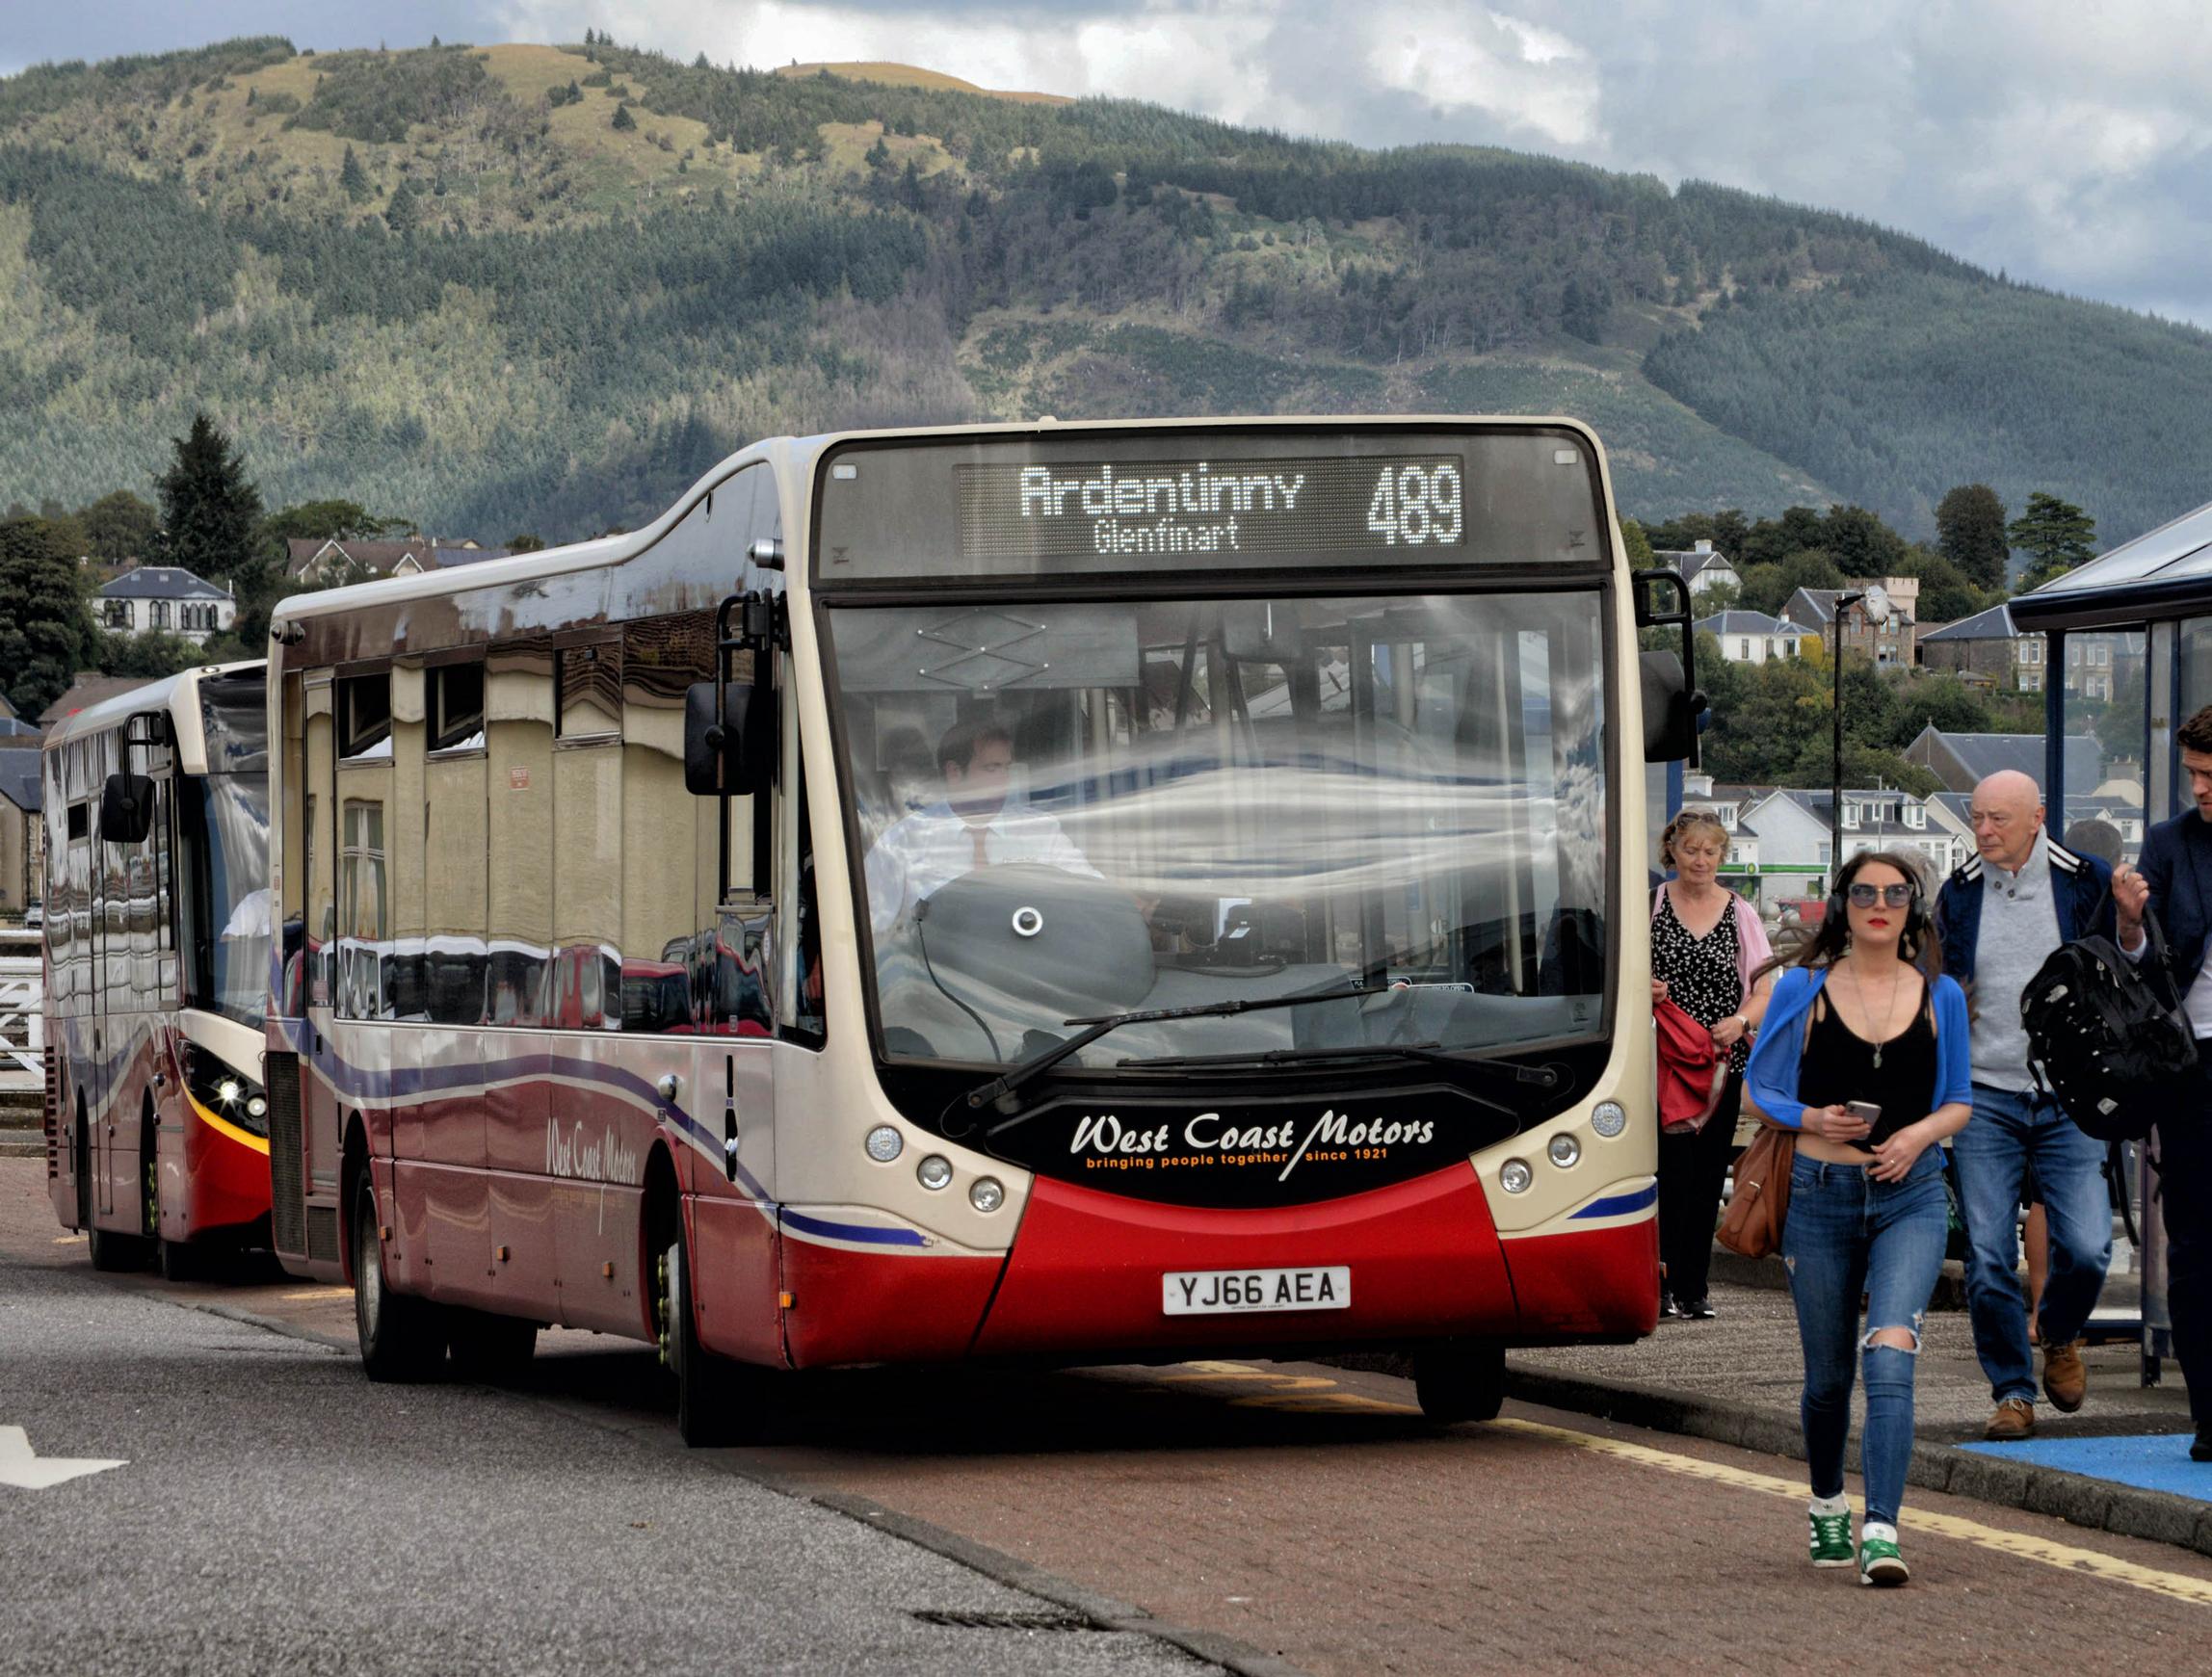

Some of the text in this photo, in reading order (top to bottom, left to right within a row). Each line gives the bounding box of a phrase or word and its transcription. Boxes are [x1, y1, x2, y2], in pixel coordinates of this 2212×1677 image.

[1019, 462, 1304, 516] Ardentinny
[1366, 464, 1462, 546] 489
[1093, 515, 1241, 554] Glenfinart
[546, 1117, 571, 1177] West
[573, 1120, 601, 1180] Coast
[1070, 1110, 1435, 1182] West Coast Motors
[1087, 1147, 1387, 1170] bringing people together since 1921
[1179, 1272, 1335, 1306] YJ66 AEA
